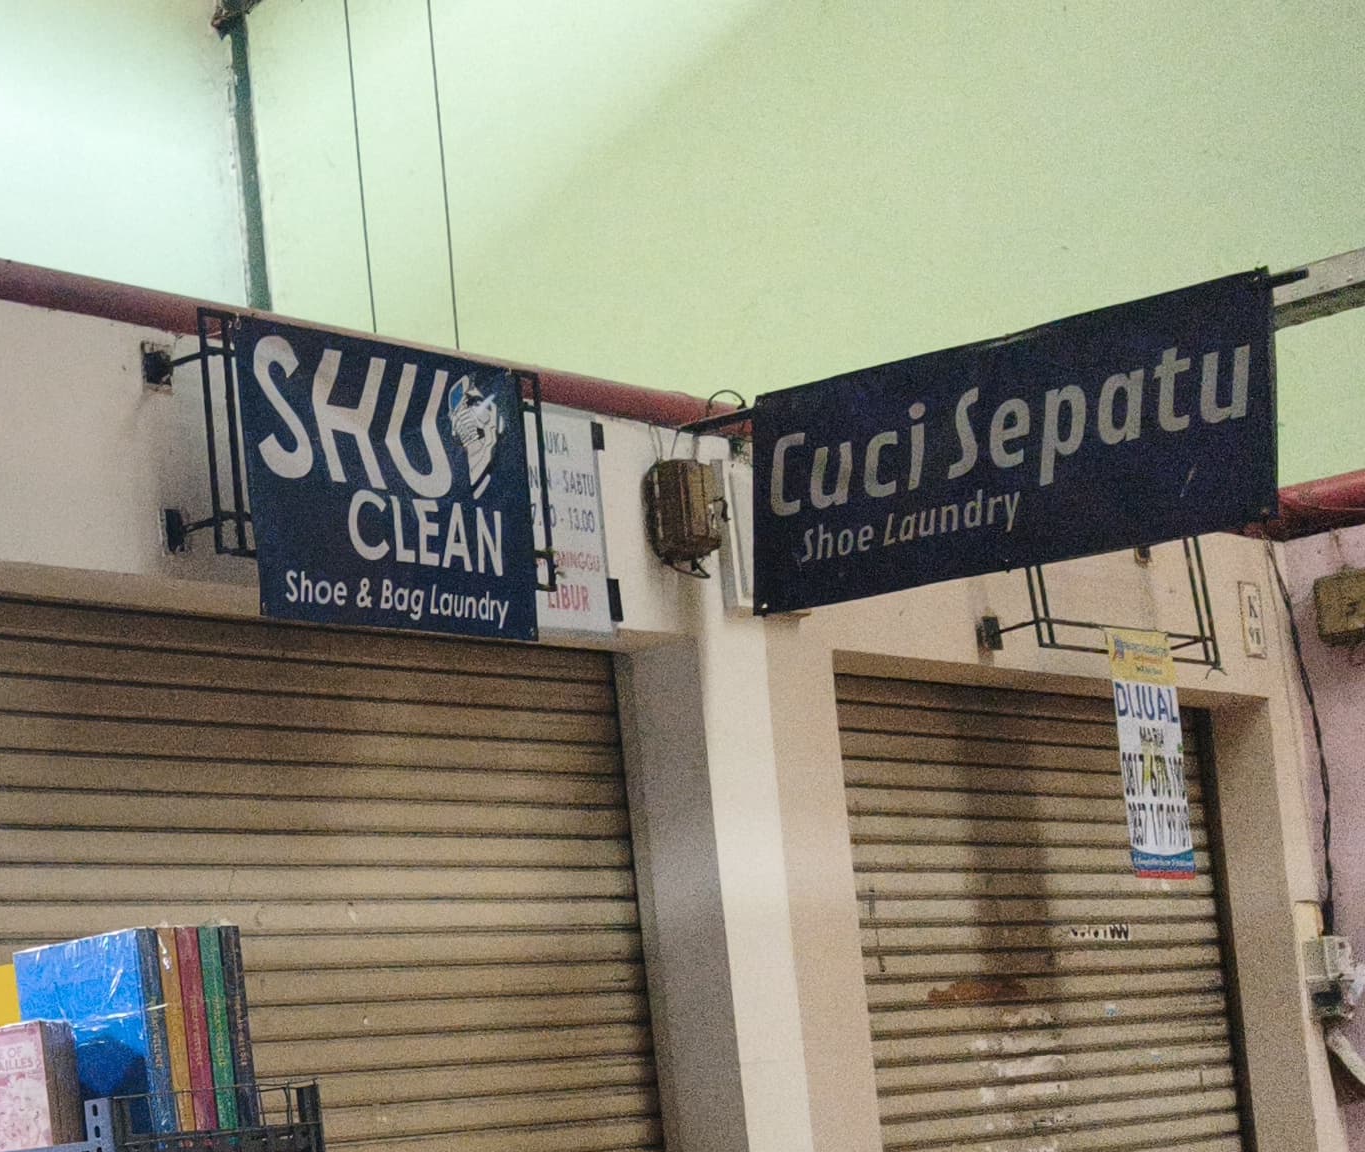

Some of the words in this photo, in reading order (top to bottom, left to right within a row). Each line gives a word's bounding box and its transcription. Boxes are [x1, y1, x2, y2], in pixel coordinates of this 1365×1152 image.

[253, 335, 453, 499] SHU
[770, 402, 925, 517] Cuci
[947, 342, 1251, 485] Sepatu
[545, 430, 568, 456] UKA
[562, 469, 596, 498] SABTU
[348, 489, 505, 578] CLEAN
[802, 520, 875, 563] Shoe
[883, 488, 1021, 546] Laundry
[285, 569, 347, 608] Shoe
[356, 577, 373, 608] &
[380, 582, 424, 621] Bag
[429, 585, 509, 629] Laundry
[548, 585, 591, 612] LIBUR
[1114, 681, 1179, 724] DIJUAL
[6, 1045, 24, 1059] OF
